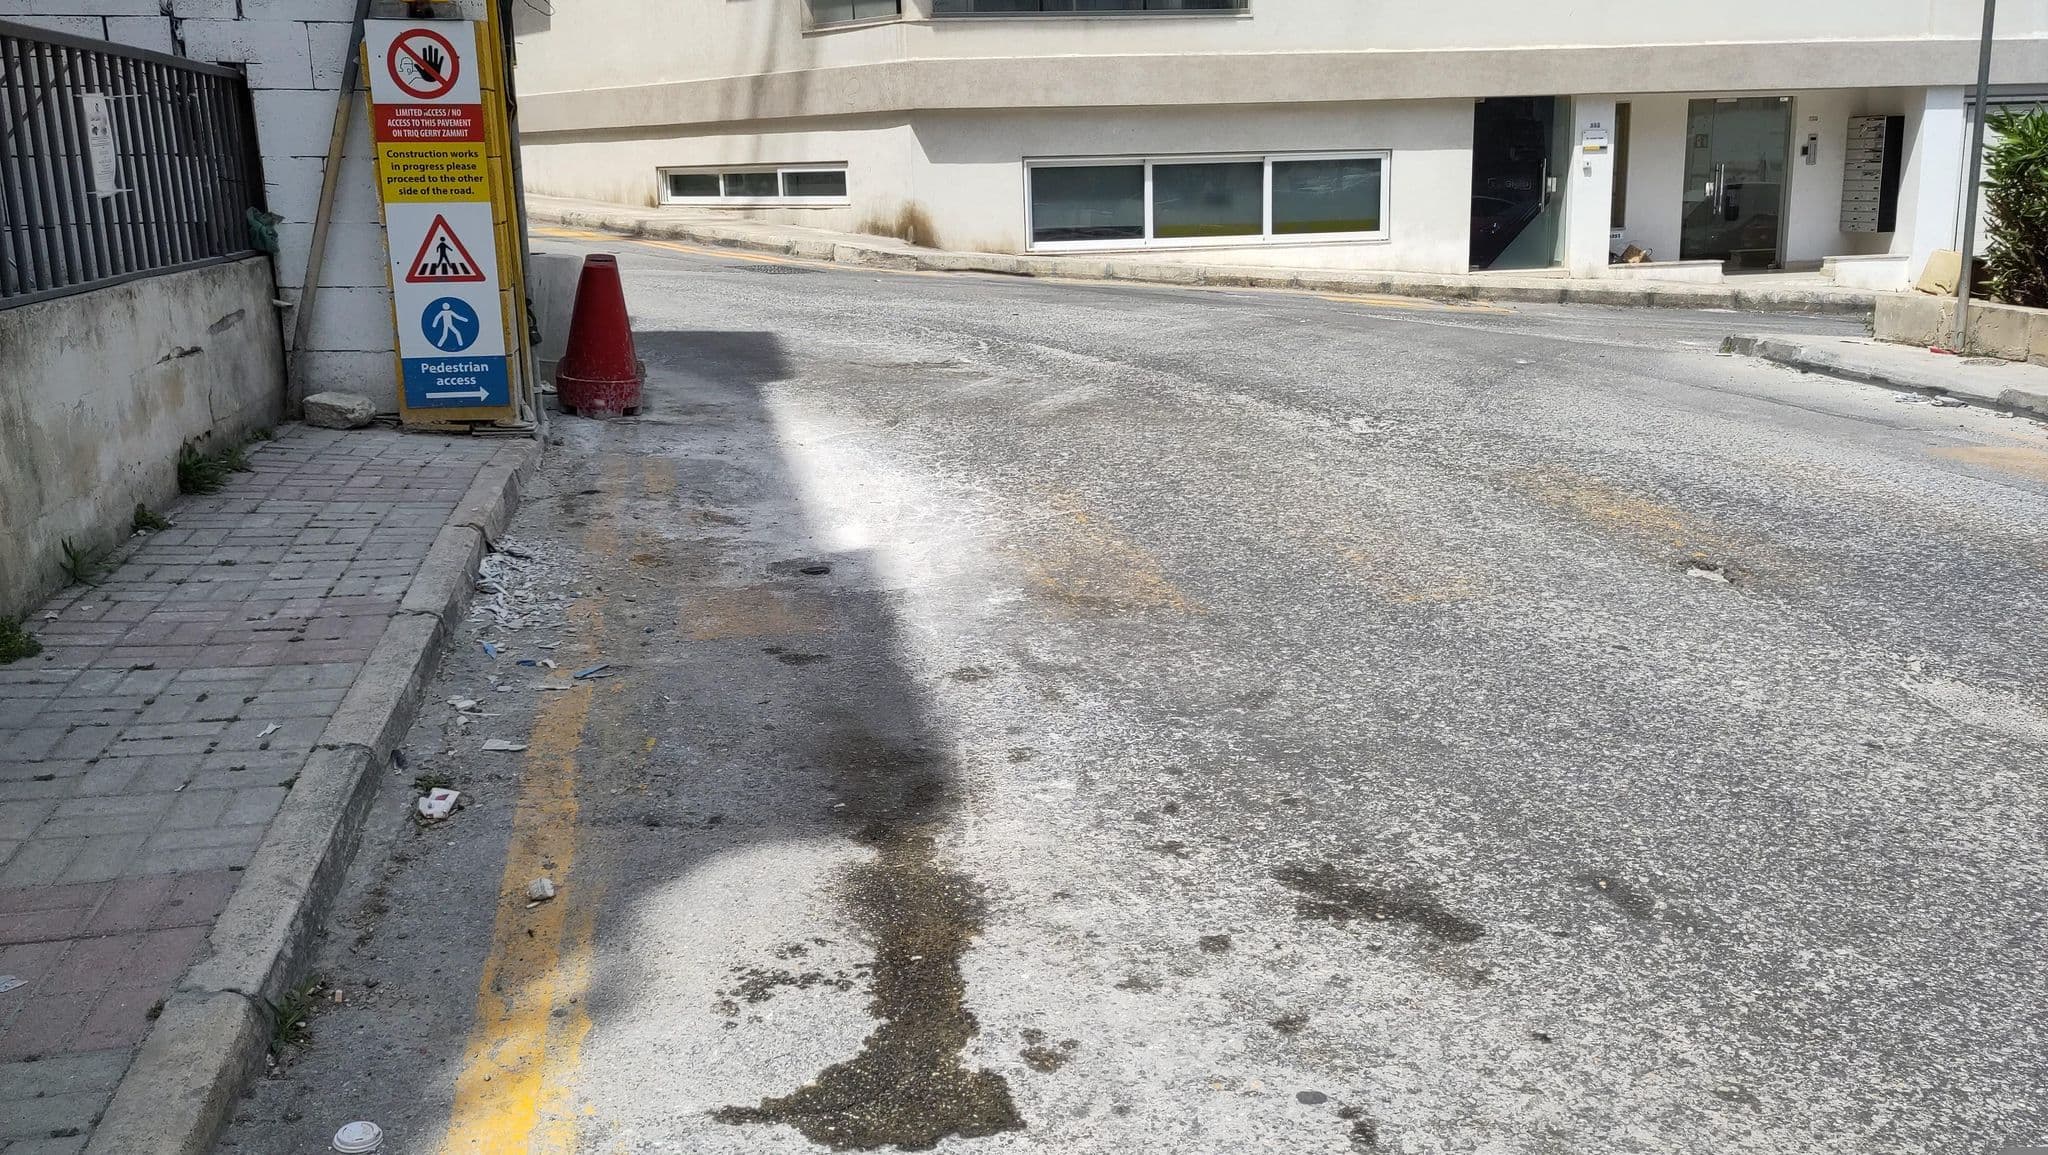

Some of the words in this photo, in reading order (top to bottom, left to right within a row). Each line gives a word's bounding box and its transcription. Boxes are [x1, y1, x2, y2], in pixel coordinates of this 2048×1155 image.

[395, 109, 422, 117] LIMITED
[452, 109, 461, 117] NO
[387, 119, 411, 127] ACCESS
[411, 119, 421, 127] TO
[421, 119, 436, 127] THIS
[437, 119, 472, 127] PAVEMENT
[392, 129, 403, 137] ON
[403, 129, 419, 138] TRIQ
[420, 129, 442, 137] GERRY
[442, 129, 469, 137] ZAMMIT
[386, 149, 448, 158] Construction
[450, 150, 479, 158] works
[391, 162, 401, 170] in
[402, 163, 445, 173] progress
[446, 162, 477, 172] please
[387, 175, 426, 185] proceed
[440, 174, 456, 183] the
[457, 174, 484, 183] other
[399, 187, 419, 195] side
[420, 187, 430, 195] of
[432, 187, 448, 195] the
[450, 187, 475, 195] road.
[421, 361, 489, 374] Pedestrian
[436, 376, 477, 386] access
